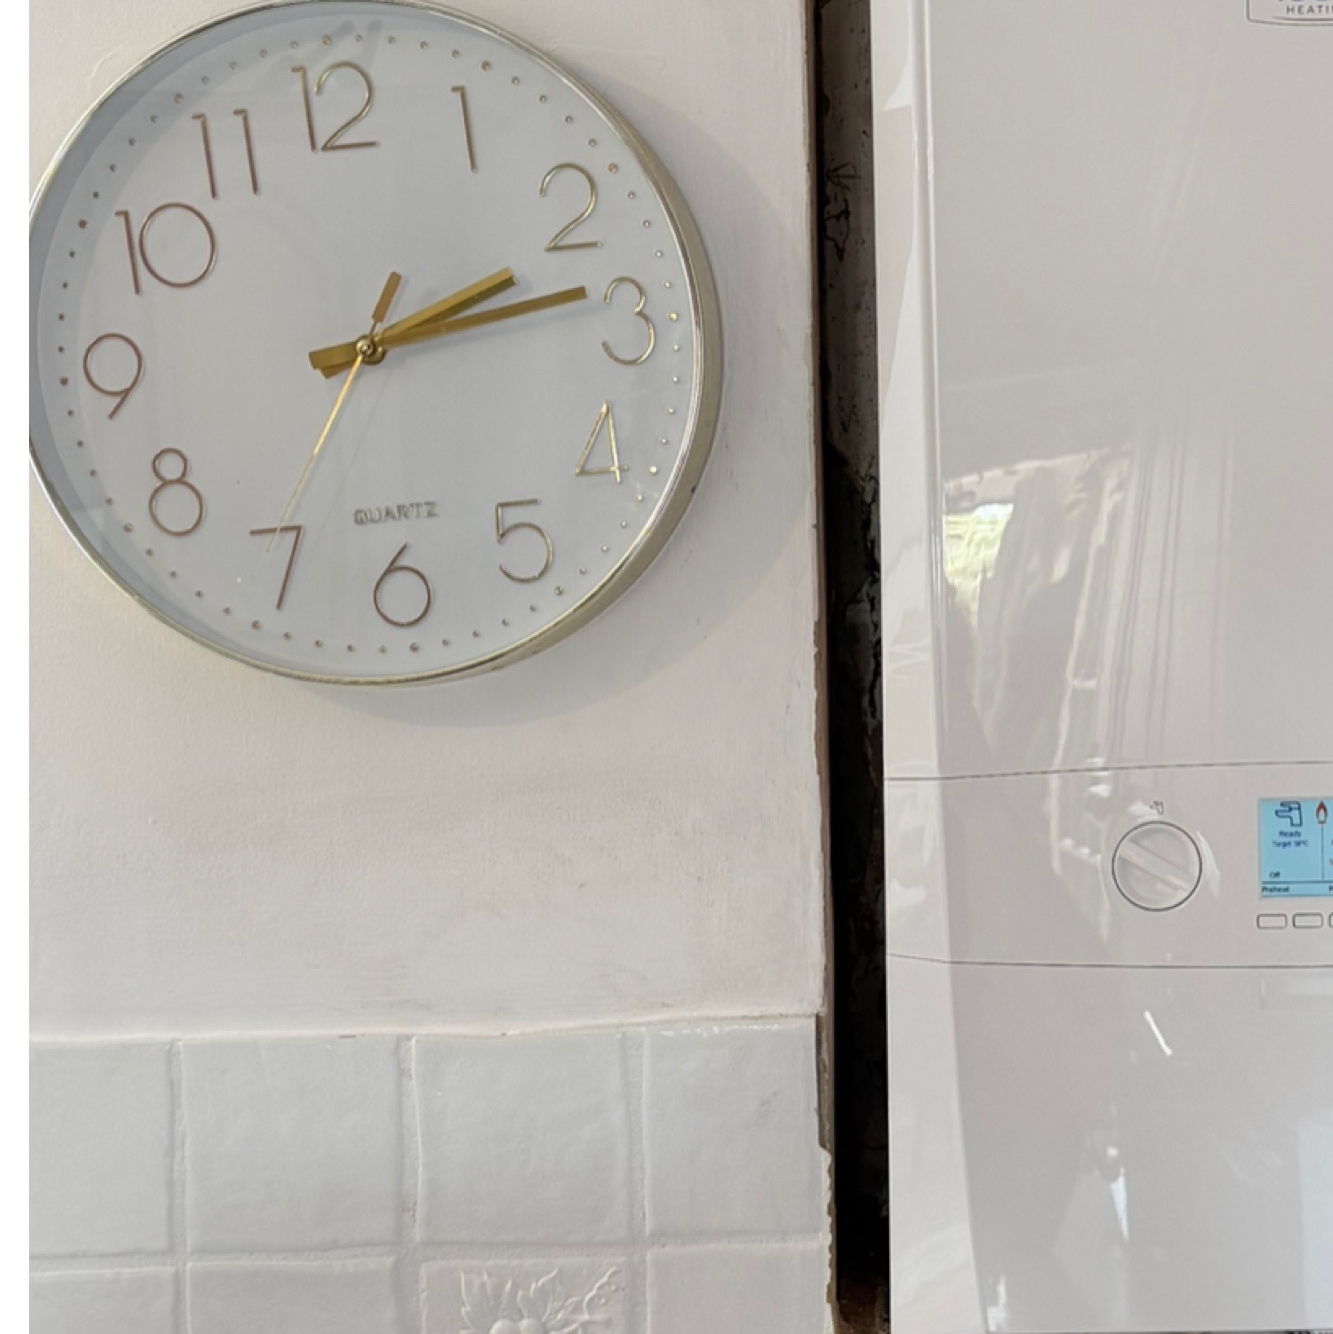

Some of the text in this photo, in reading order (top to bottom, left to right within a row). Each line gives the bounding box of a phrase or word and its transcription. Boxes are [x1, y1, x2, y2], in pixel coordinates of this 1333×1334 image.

[291, 62, 379, 152] 12
[451, 85, 478, 173] 1
[191, 109, 260, 199] 11
[116, 202, 217, 295] 10
[540, 163, 602, 252] 2
[601, 277, 656, 366] 3
[82, 332, 145, 419] 9
[576, 401, 631, 485] 4
[149, 447, 205, 537] 8
[352, 501, 440, 526] QUARTZ
[250, 525, 303, 610] 7
[373, 542, 433, 627] 6
[494, 498, 556, 584] 5
